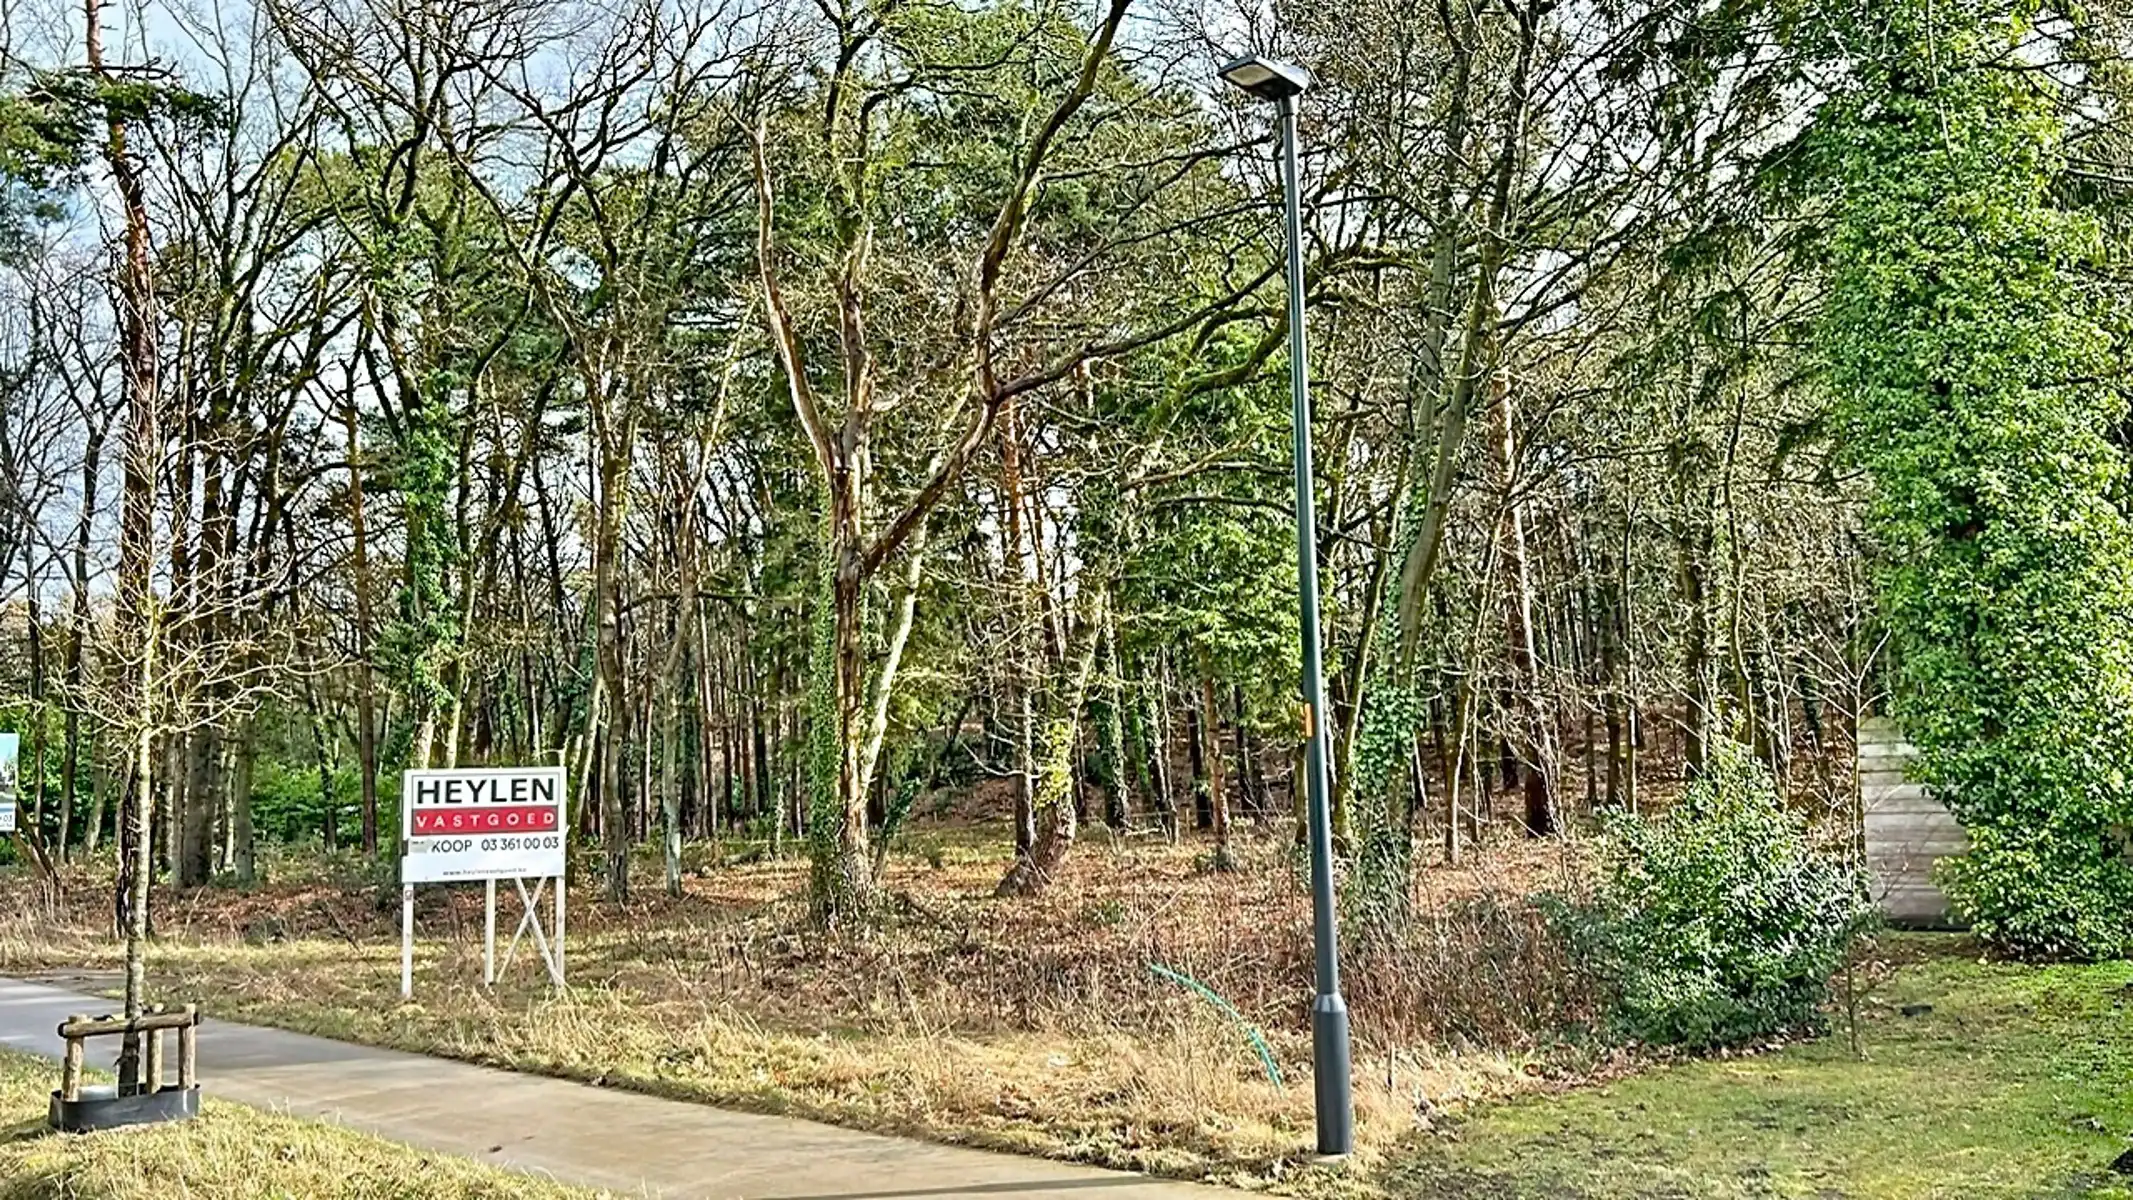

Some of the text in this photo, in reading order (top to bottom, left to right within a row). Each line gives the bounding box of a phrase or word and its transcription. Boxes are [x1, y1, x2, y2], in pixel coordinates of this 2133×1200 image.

[417, 778, 554, 804] HEYLEN
[416, 812, 554, 828] VASTGOED
[431, 840, 472, 853] KOOP
[481, 838, 497, 852] 03
[500, 838, 520, 851] 361
[523, 837, 540, 850] 00
[543, 836, 559, 849] 03
